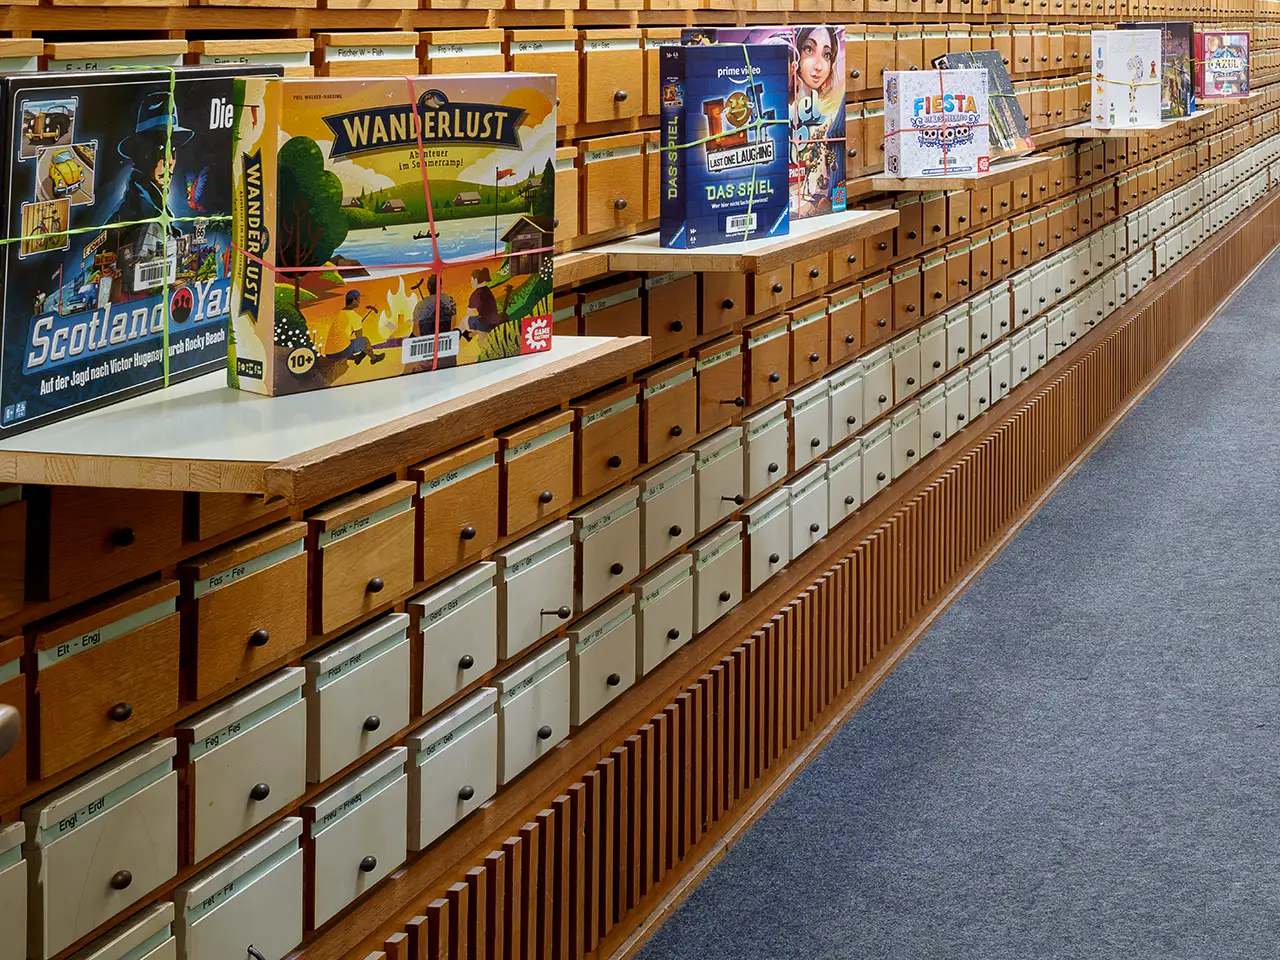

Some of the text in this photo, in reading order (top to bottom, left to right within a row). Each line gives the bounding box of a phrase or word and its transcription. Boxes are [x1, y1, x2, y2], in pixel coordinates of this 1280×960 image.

[717, 67, 740, 79] prime
[1214, 59, 1239, 69] AZUL
[209, 97, 232, 130] Die
[913, 93, 978, 117] FIESTA
[342, 108, 509, 149] WANDERLUST
[409, 149, 449, 160] Abnteuer
[667, 116, 679, 200] DAS SPIEL
[710, 144, 773, 169] LAST ONE LAUGHING
[399, 161, 410, 171] im
[705, 180, 775, 201] DAS SPIEL
[197, 226, 204, 238] 66
[244, 162, 262, 306] WANDERLUST
[27, 278, 231, 370] Scotland Yar
[534, 326, 551, 337] GAME
[40, 329, 226, 395] Auf der Jagd nach Victor Hugenay urch Rocky Beach
[290, 353, 314, 370] 10+
[330, 516, 370, 540] Frank Franz
[232, 566, 246, 579] Fee
[57, 643, 70, 658] Elt
[205, 734, 220, 750] Feg
